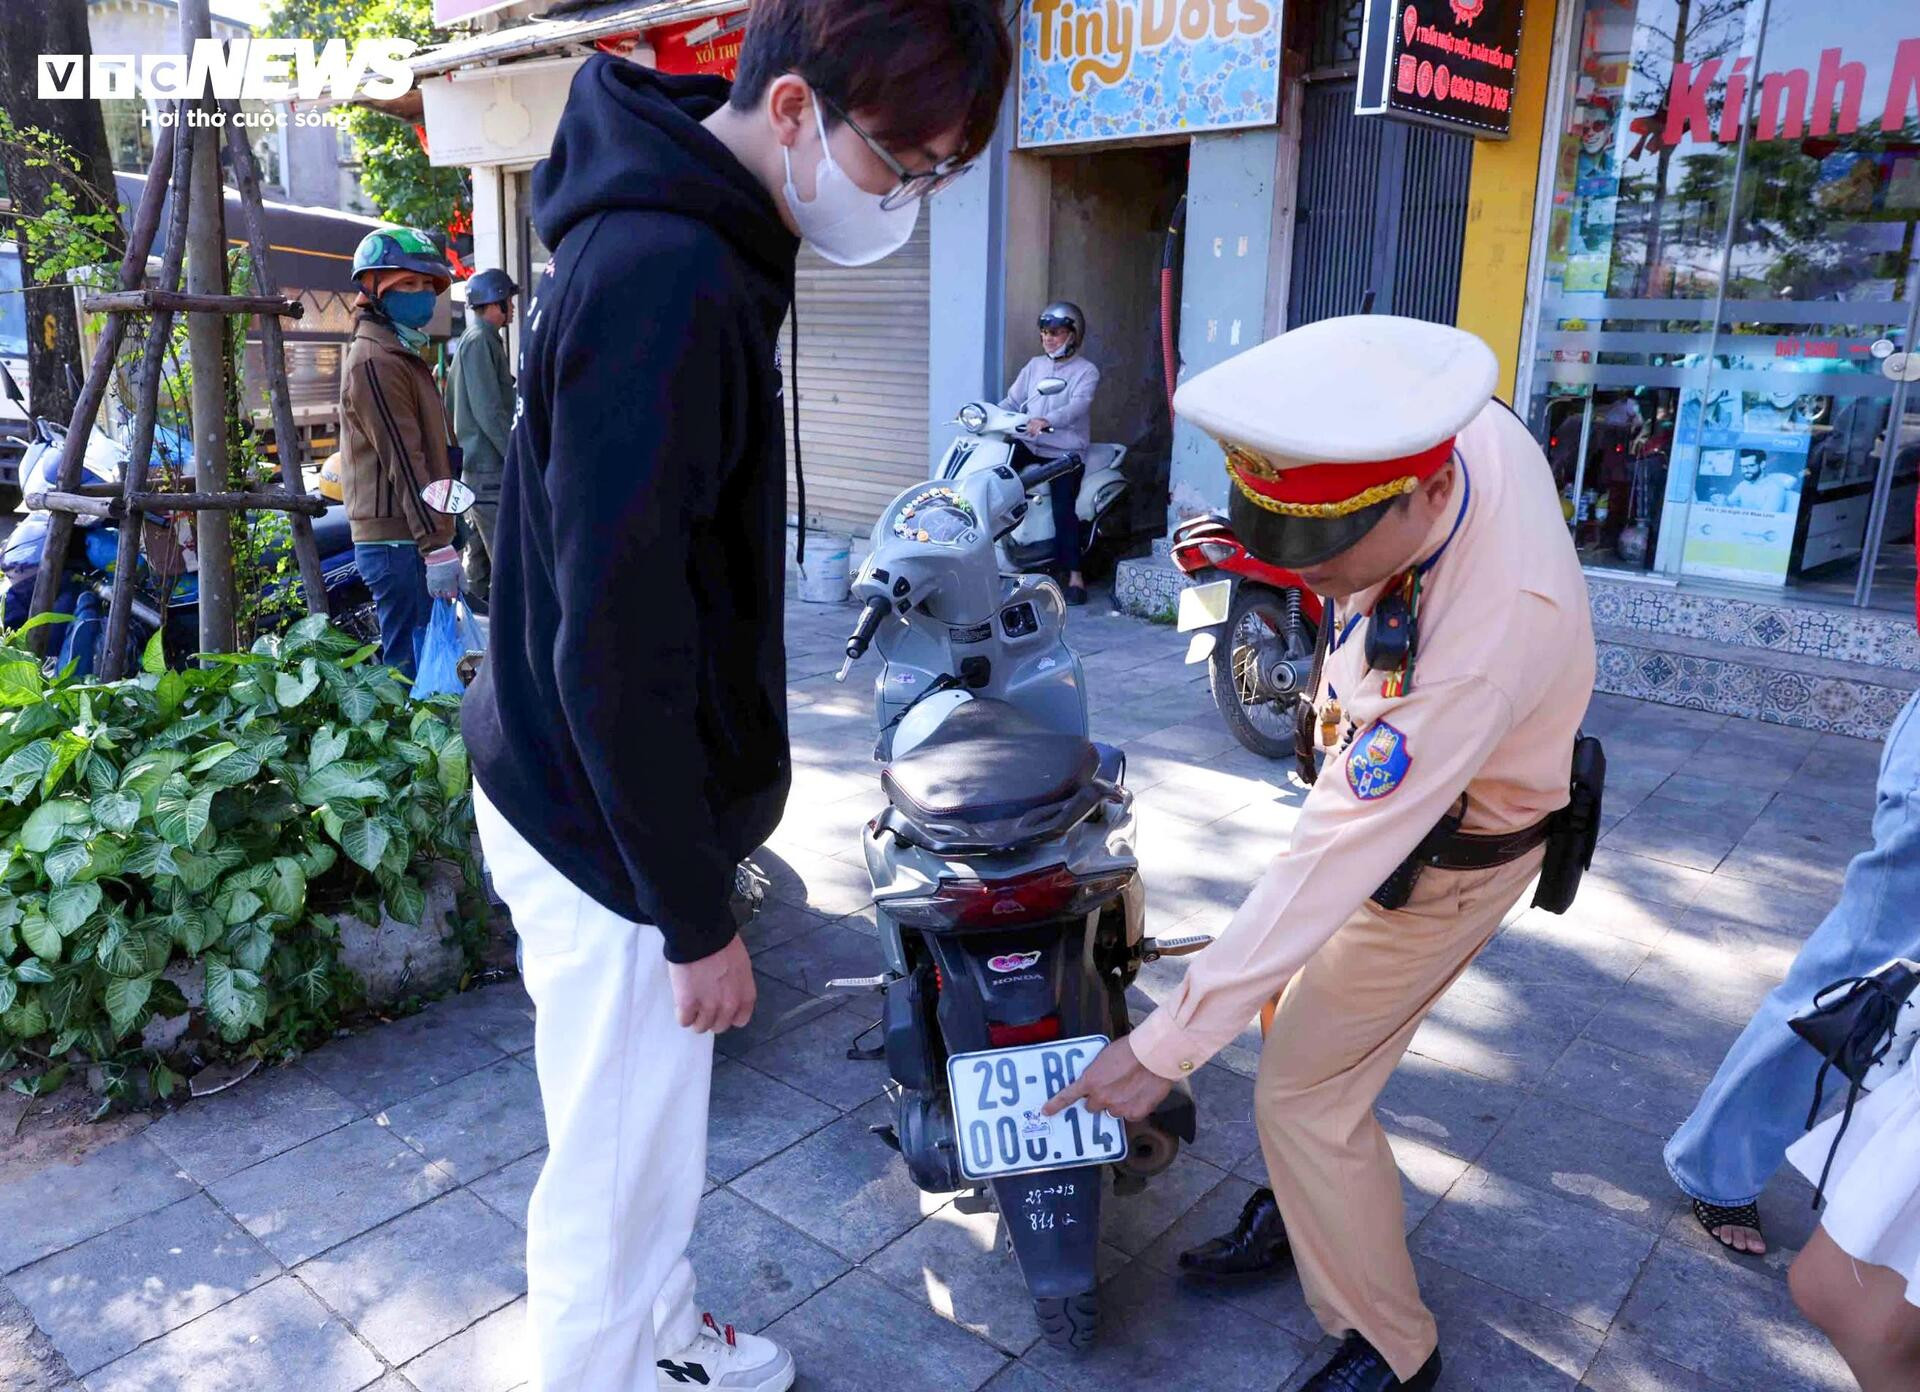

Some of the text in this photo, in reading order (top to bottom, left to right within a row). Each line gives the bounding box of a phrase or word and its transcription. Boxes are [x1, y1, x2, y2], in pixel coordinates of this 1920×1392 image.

[1032, 0, 1270, 92] Tiny Dots
[1663, 47, 1867, 145] Kính
[1353, 754, 1368, 770] CS
[1373, 767, 1392, 782] GT
[992, 974, 1044, 986] HONDA
